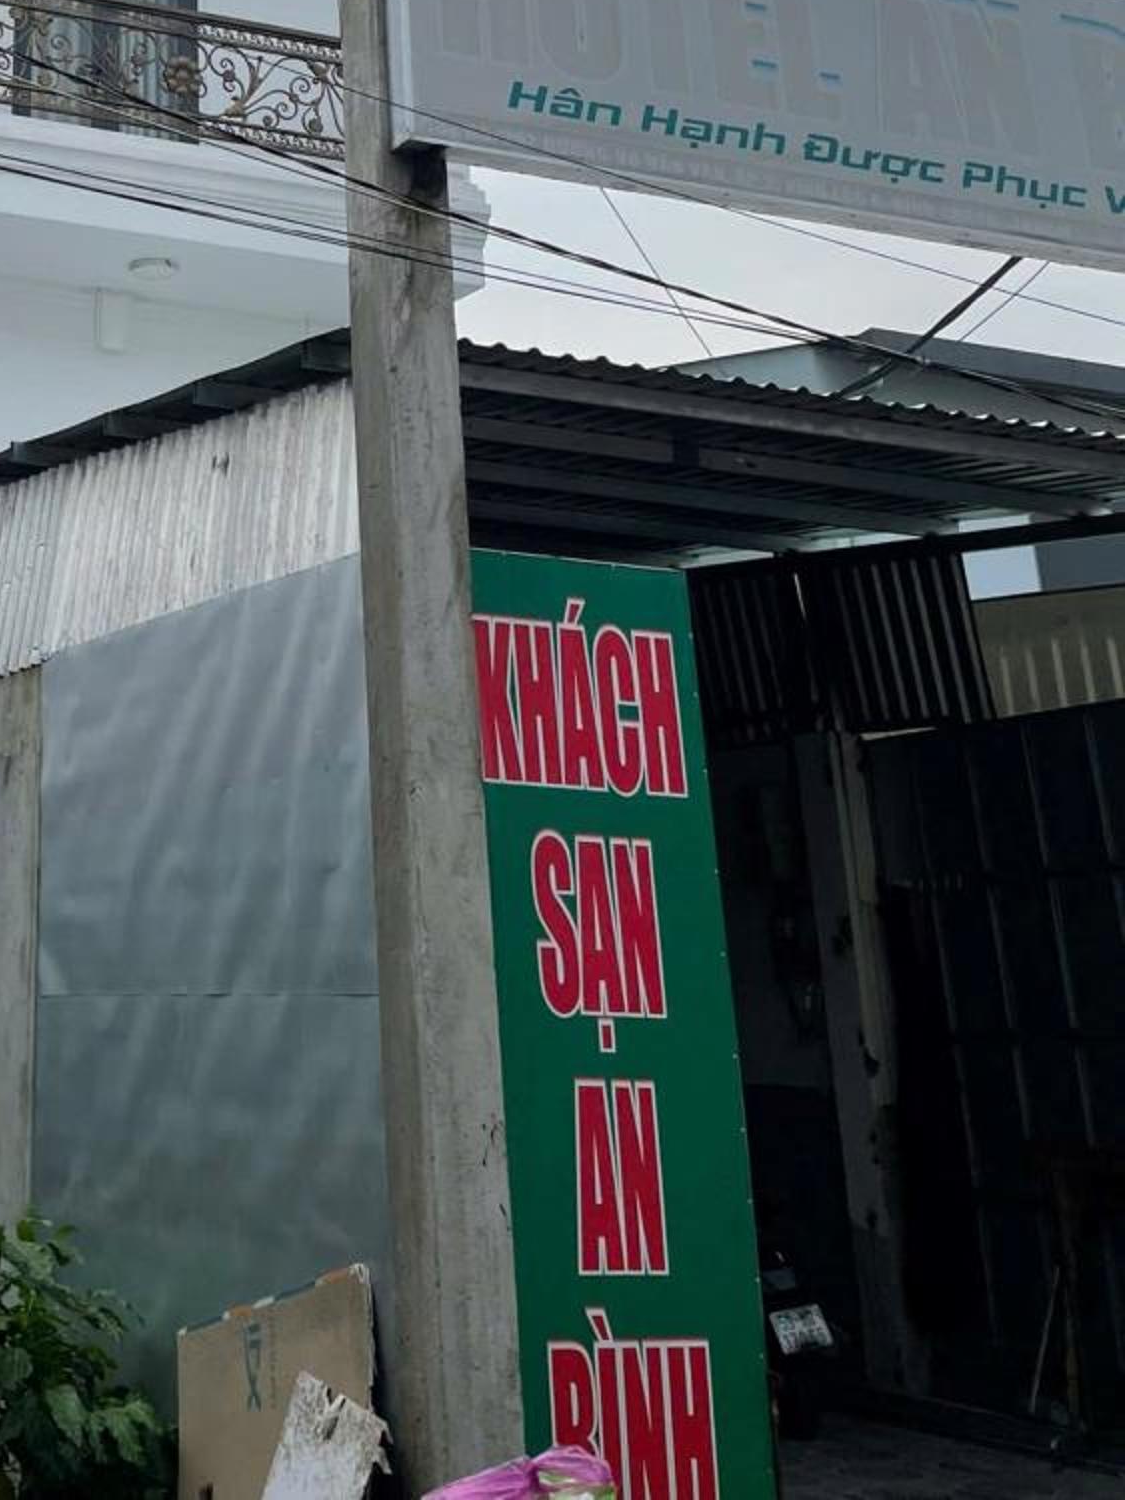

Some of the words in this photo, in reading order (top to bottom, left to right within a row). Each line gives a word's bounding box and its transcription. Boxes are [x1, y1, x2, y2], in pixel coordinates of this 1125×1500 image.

[507, 81, 622, 126] Hân
[641, 105, 786, 155] Hạnh
[803, 133, 946, 184] Được
[962, 161, 1088, 209] Phục
[471, 597, 689, 798] KHÁCH
[531, 829, 667, 1053] SẠN
[575, 1078, 670, 1276] AN
